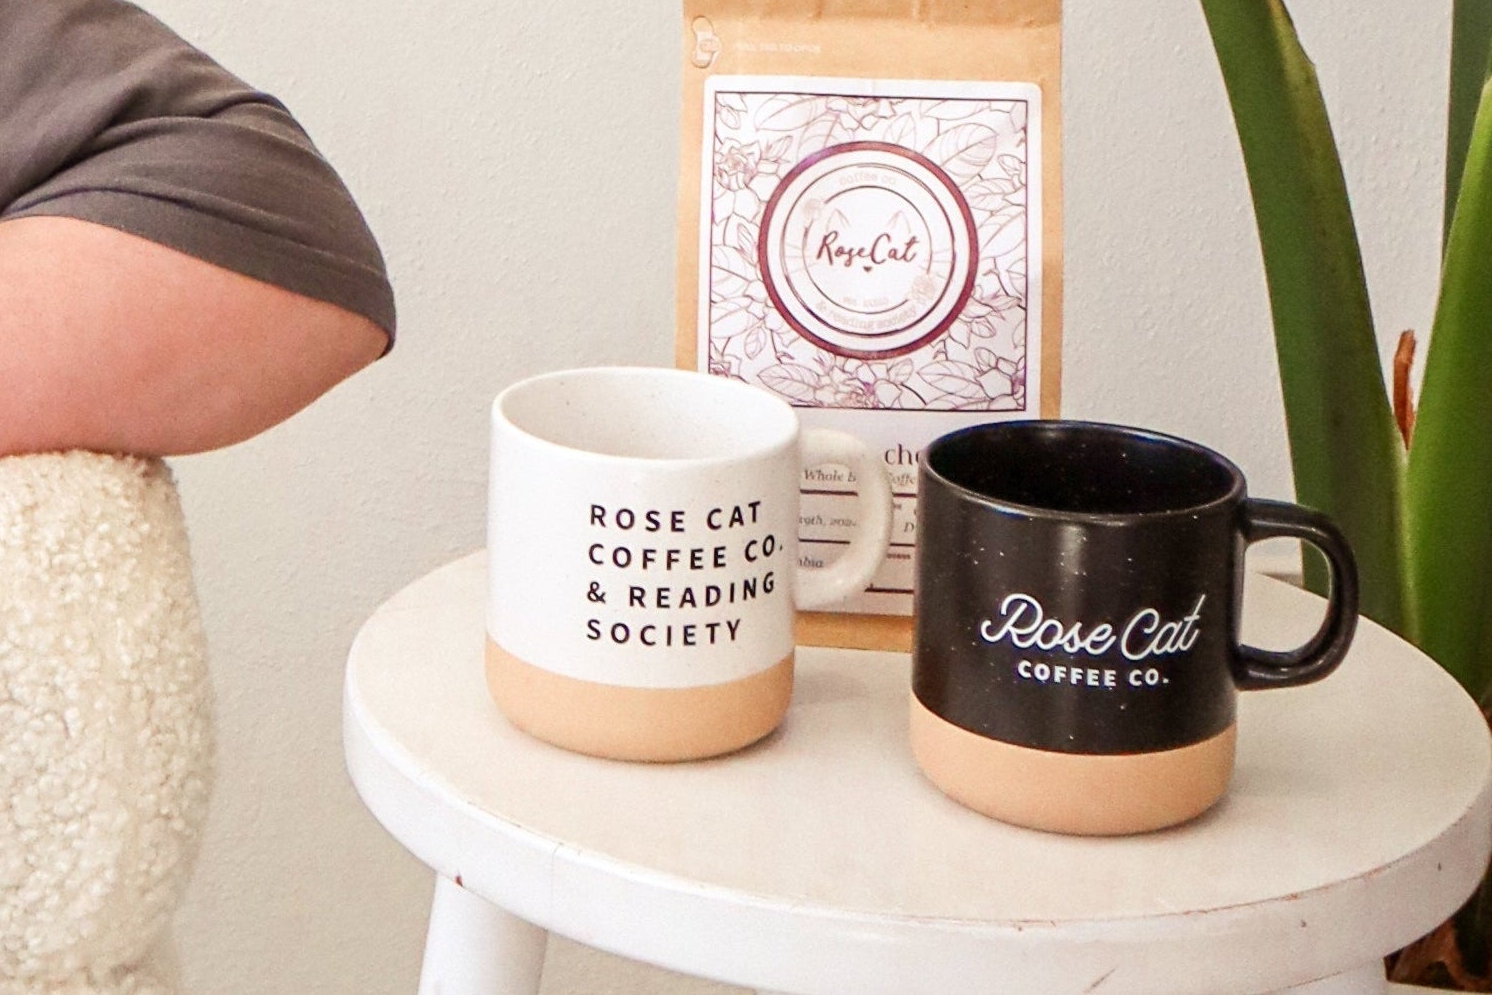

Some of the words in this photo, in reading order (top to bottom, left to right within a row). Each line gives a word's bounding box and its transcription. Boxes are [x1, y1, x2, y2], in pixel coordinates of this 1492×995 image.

[590, 503, 685, 533] ROSE
[706, 500, 761, 531] CAT
[588, 543, 726, 570] COFFEE
[744, 534, 783, 563] CO.
[586, 581, 606, 604] &
[629, 571, 774, 609] READING
[586, 618, 741, 647] SOCIETY
[980, 592, 1117, 656] Rose
[1120, 593, 1206, 661] Cat
[1017, 659, 1117, 687] COFFEE
[1128, 668, 1170, 687] CO.
